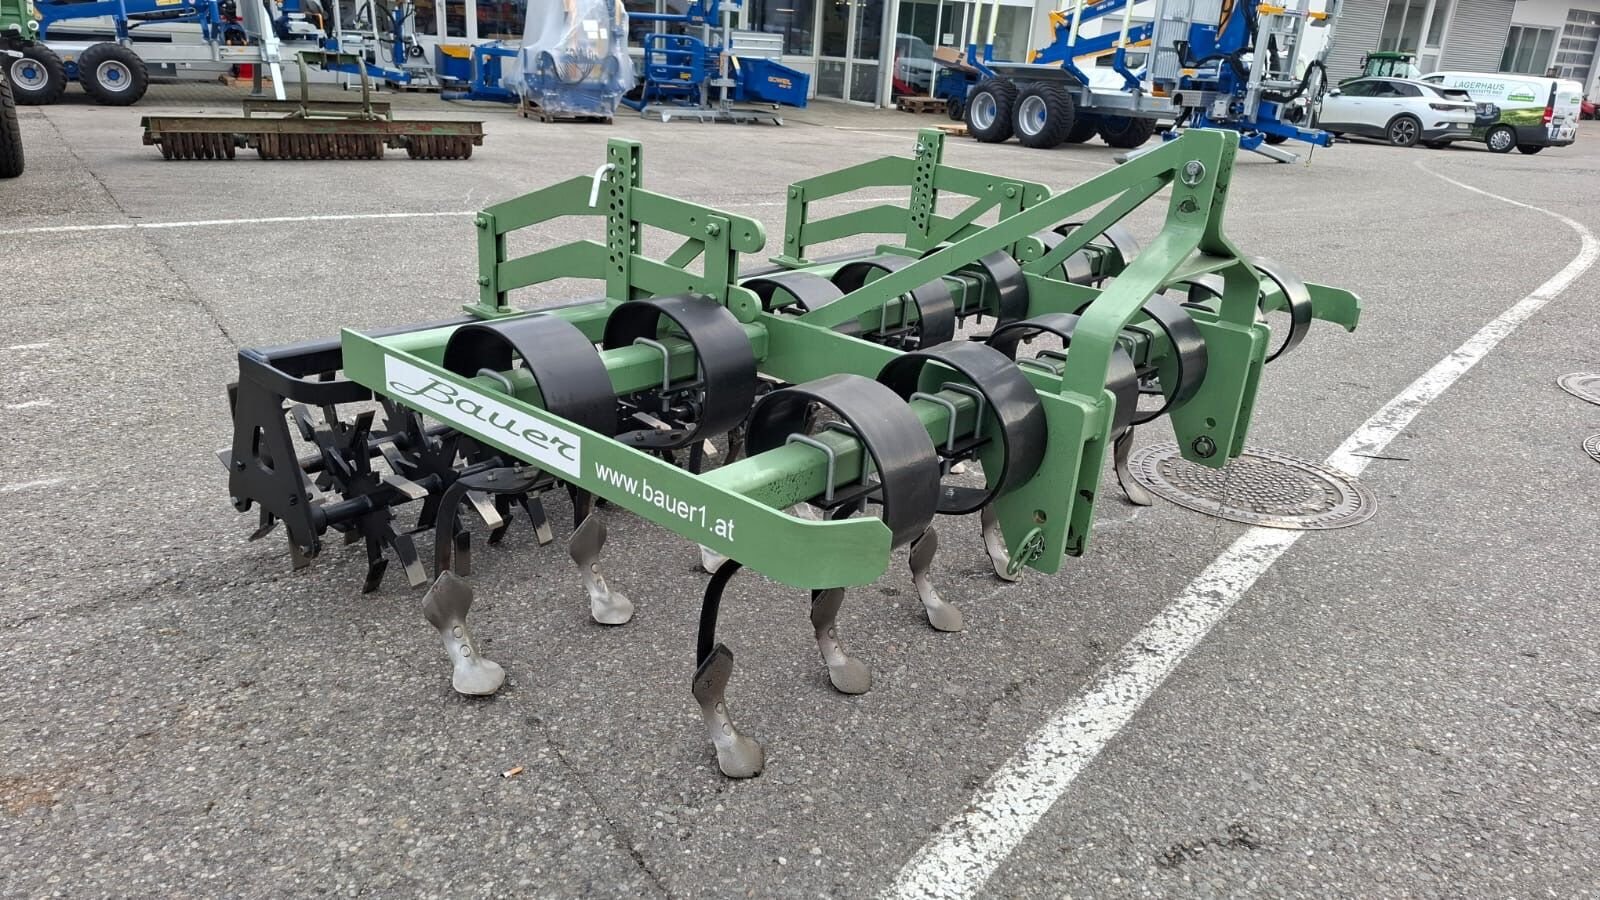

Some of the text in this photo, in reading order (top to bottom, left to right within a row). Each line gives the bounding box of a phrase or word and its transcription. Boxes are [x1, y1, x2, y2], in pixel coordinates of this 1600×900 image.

[1453, 80, 1505, 90] LAGERHAUS
[390, 377, 577, 462] Bauer
[595, 462, 735, 542] www.bauer1.at
